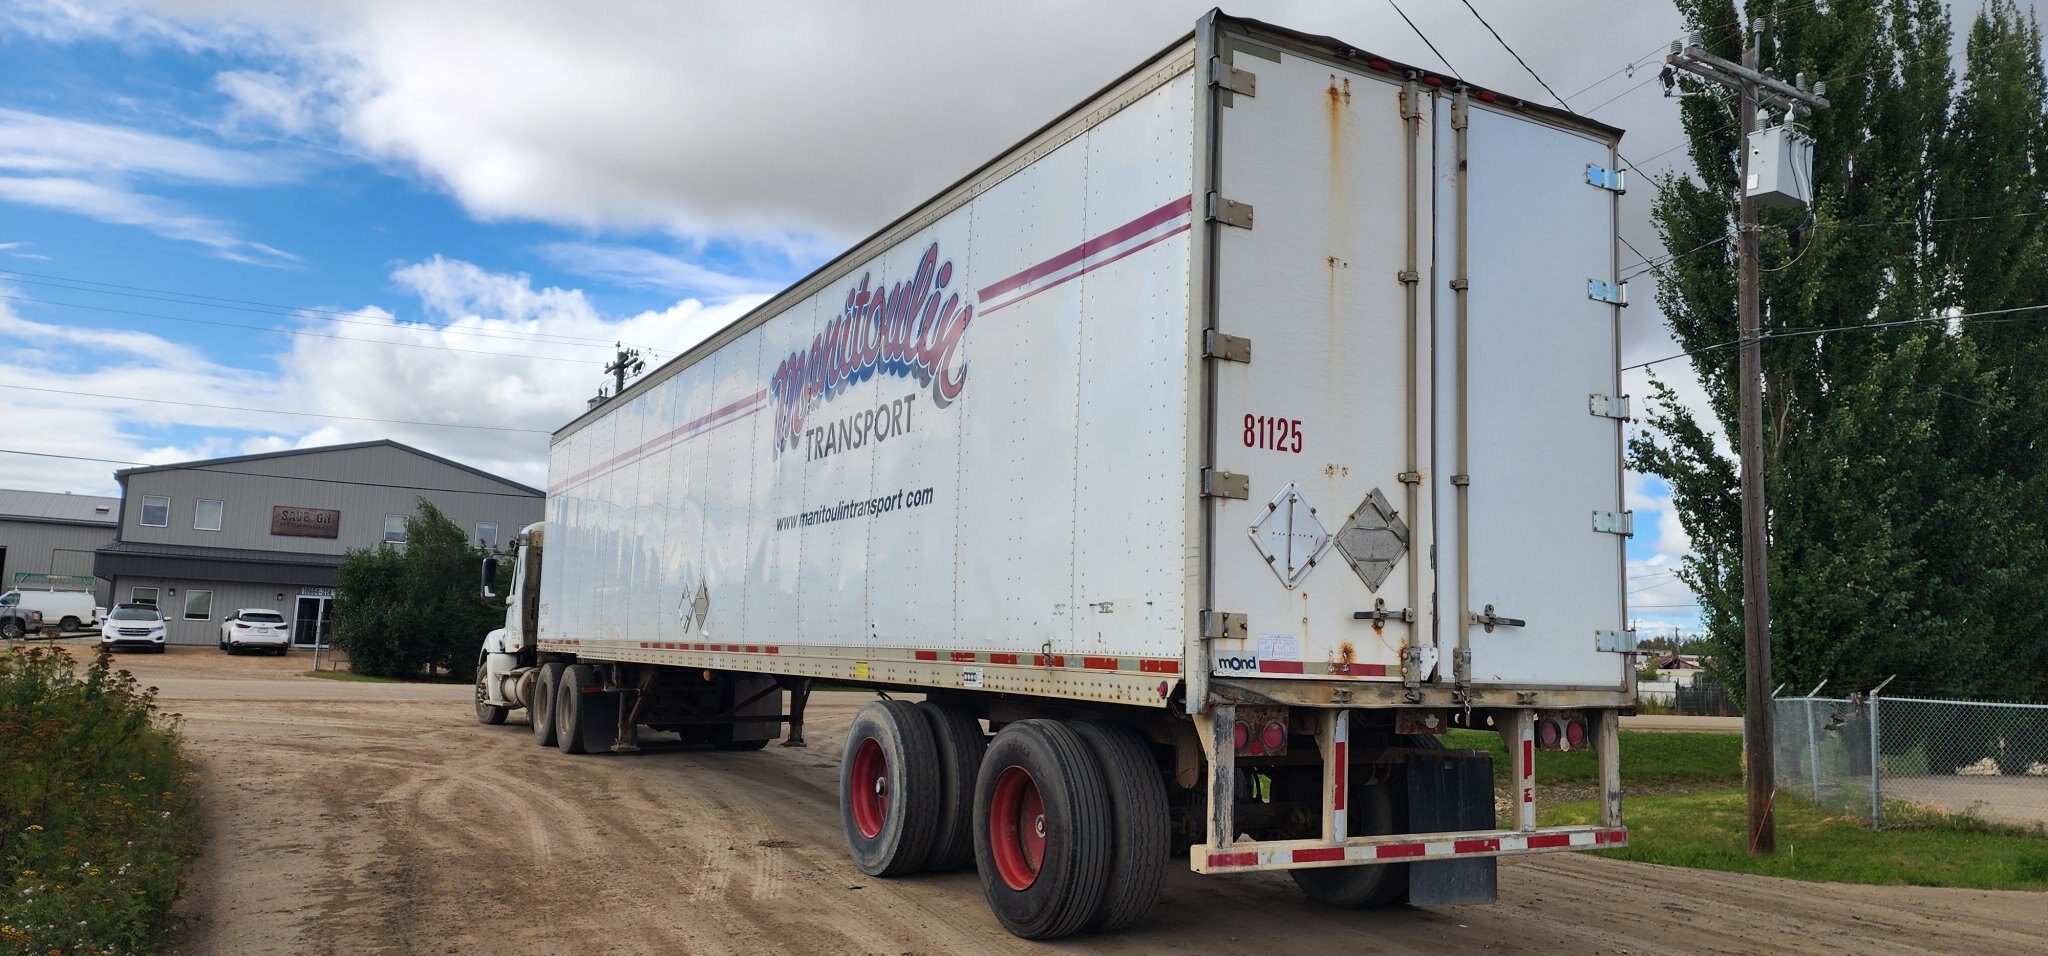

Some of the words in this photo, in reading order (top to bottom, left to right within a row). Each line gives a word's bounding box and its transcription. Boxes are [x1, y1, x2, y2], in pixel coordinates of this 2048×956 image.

[806, 393, 916, 462] TRANSPORT
[1243, 413, 1303, 454] 81125
[316, 512, 332, 524] ON
